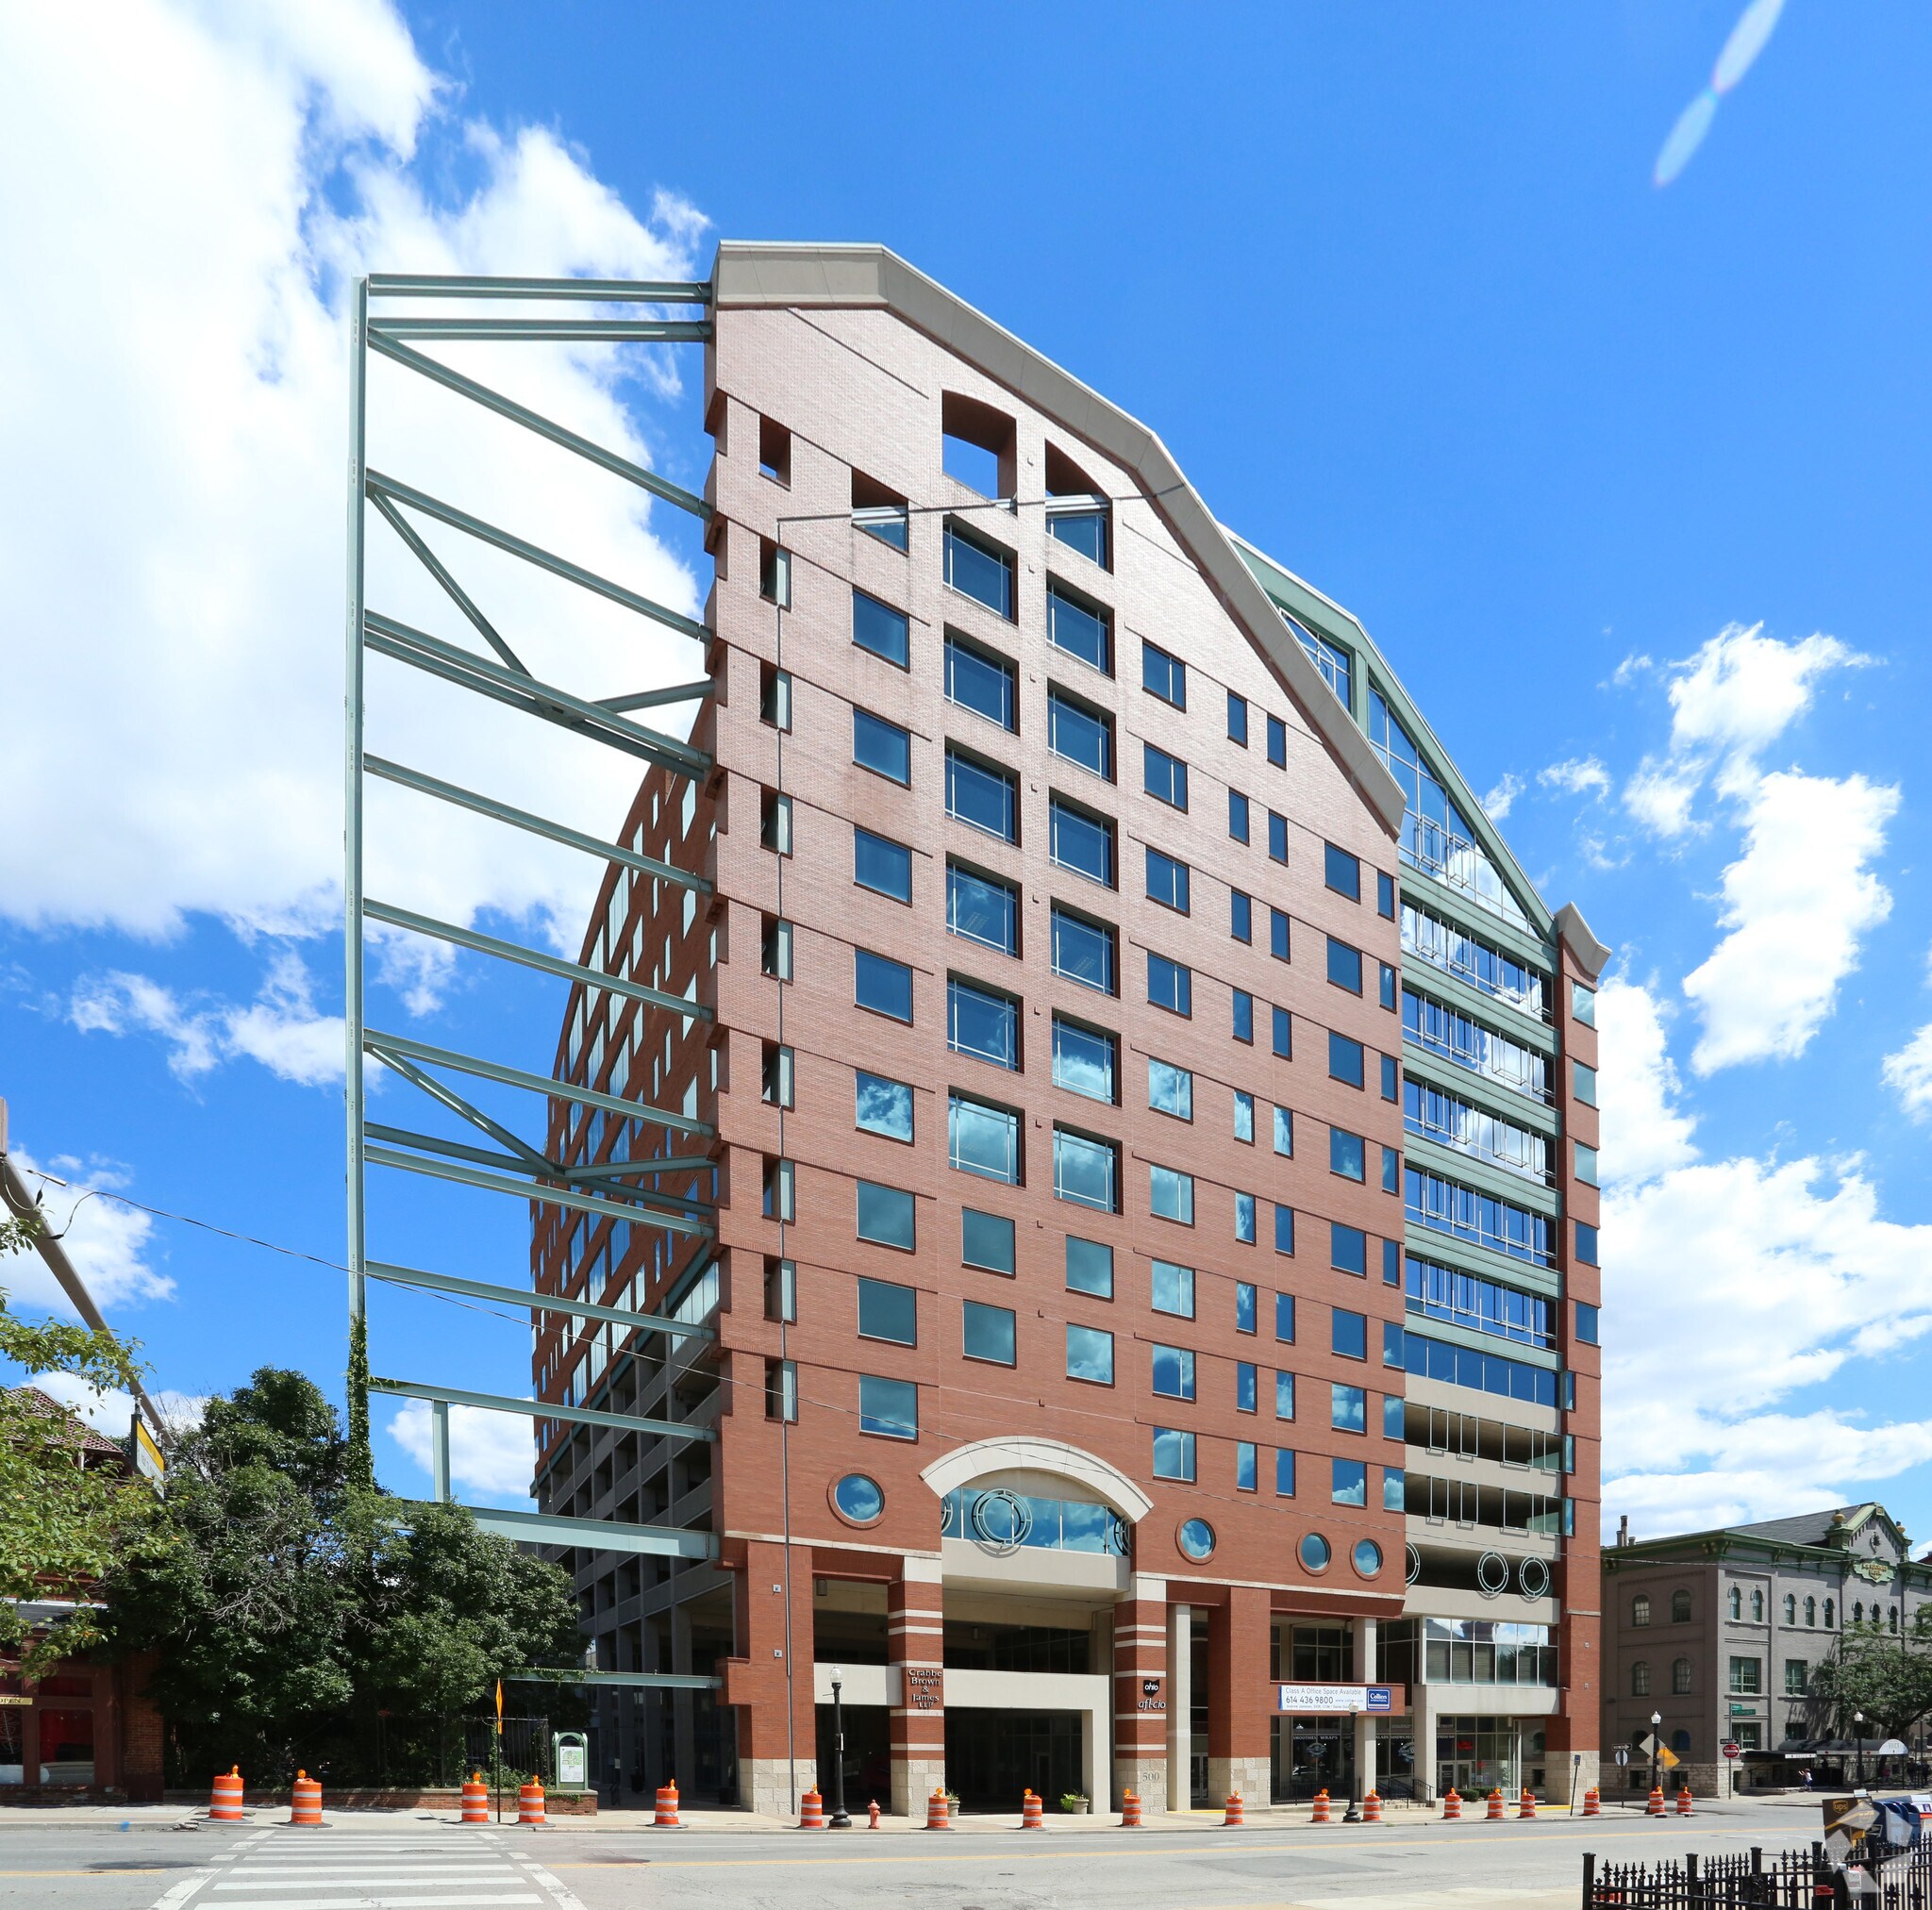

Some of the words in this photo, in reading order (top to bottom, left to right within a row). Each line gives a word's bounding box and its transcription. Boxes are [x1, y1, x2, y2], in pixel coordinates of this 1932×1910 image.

[908, 1669, 942, 1677] Crabbe
[1144, 1682, 1158, 1691] ohio
[1323, 1687, 1339, 1696] Space
[1138, 1698, 1166, 1711] afl-cio
[1300, 1696, 1313, 1704] 436
[1315, 1696, 1334, 1704] 9800
[1142, 1773, 1160, 1782] 500
[1834, 1803, 1847, 1812] ups
